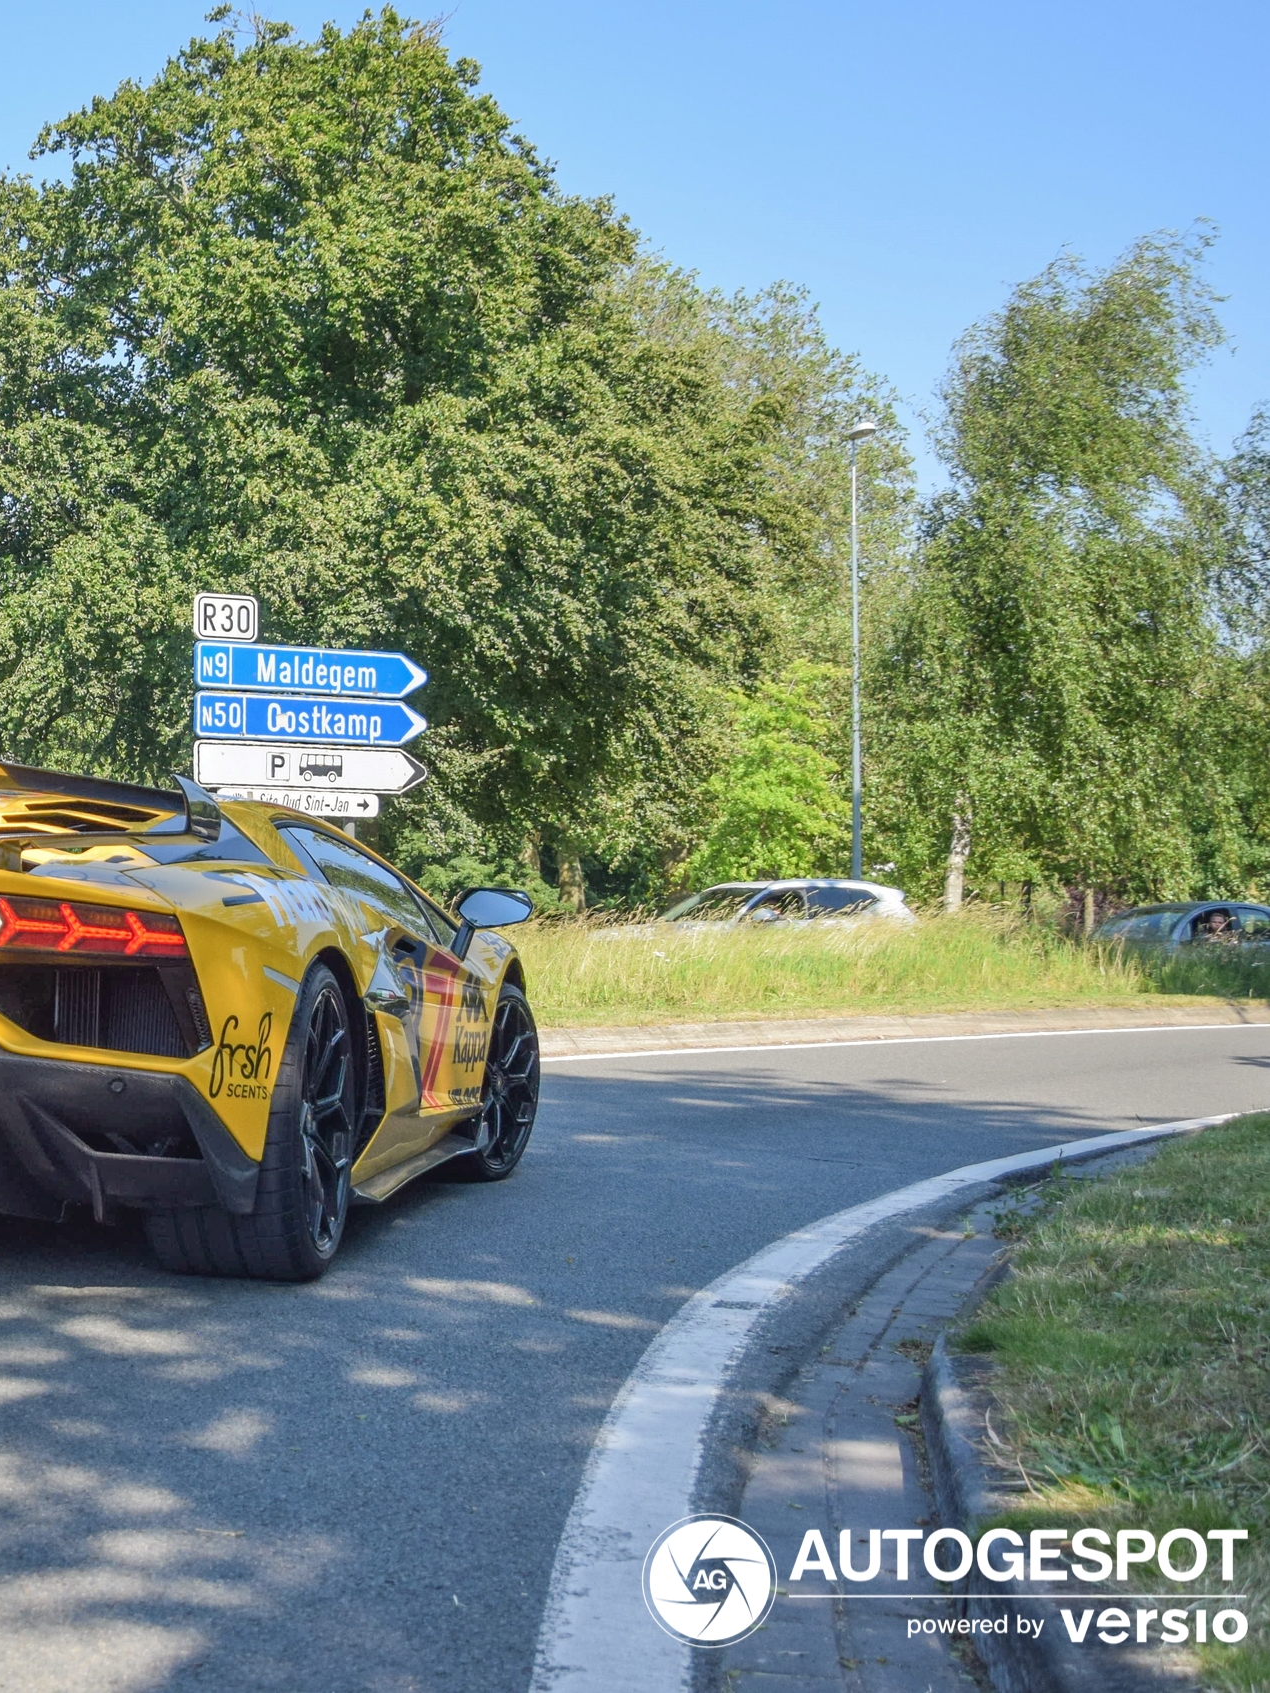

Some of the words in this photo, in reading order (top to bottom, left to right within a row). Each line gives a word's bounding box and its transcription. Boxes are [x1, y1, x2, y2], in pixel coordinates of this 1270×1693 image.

[203, 602, 250, 633] R30
[202, 652, 228, 677] N9
[257, 653, 377, 694] Maldegem
[202, 702, 241, 728] N50
[267, 702, 381, 744] Oostkamp
[304, 795, 350, 814] Sint-Jan
[209, 1011, 273, 1098] frsh
[452, 1025, 487, 1073] Kappa
[226, 1083, 268, 1100] SCENTS
